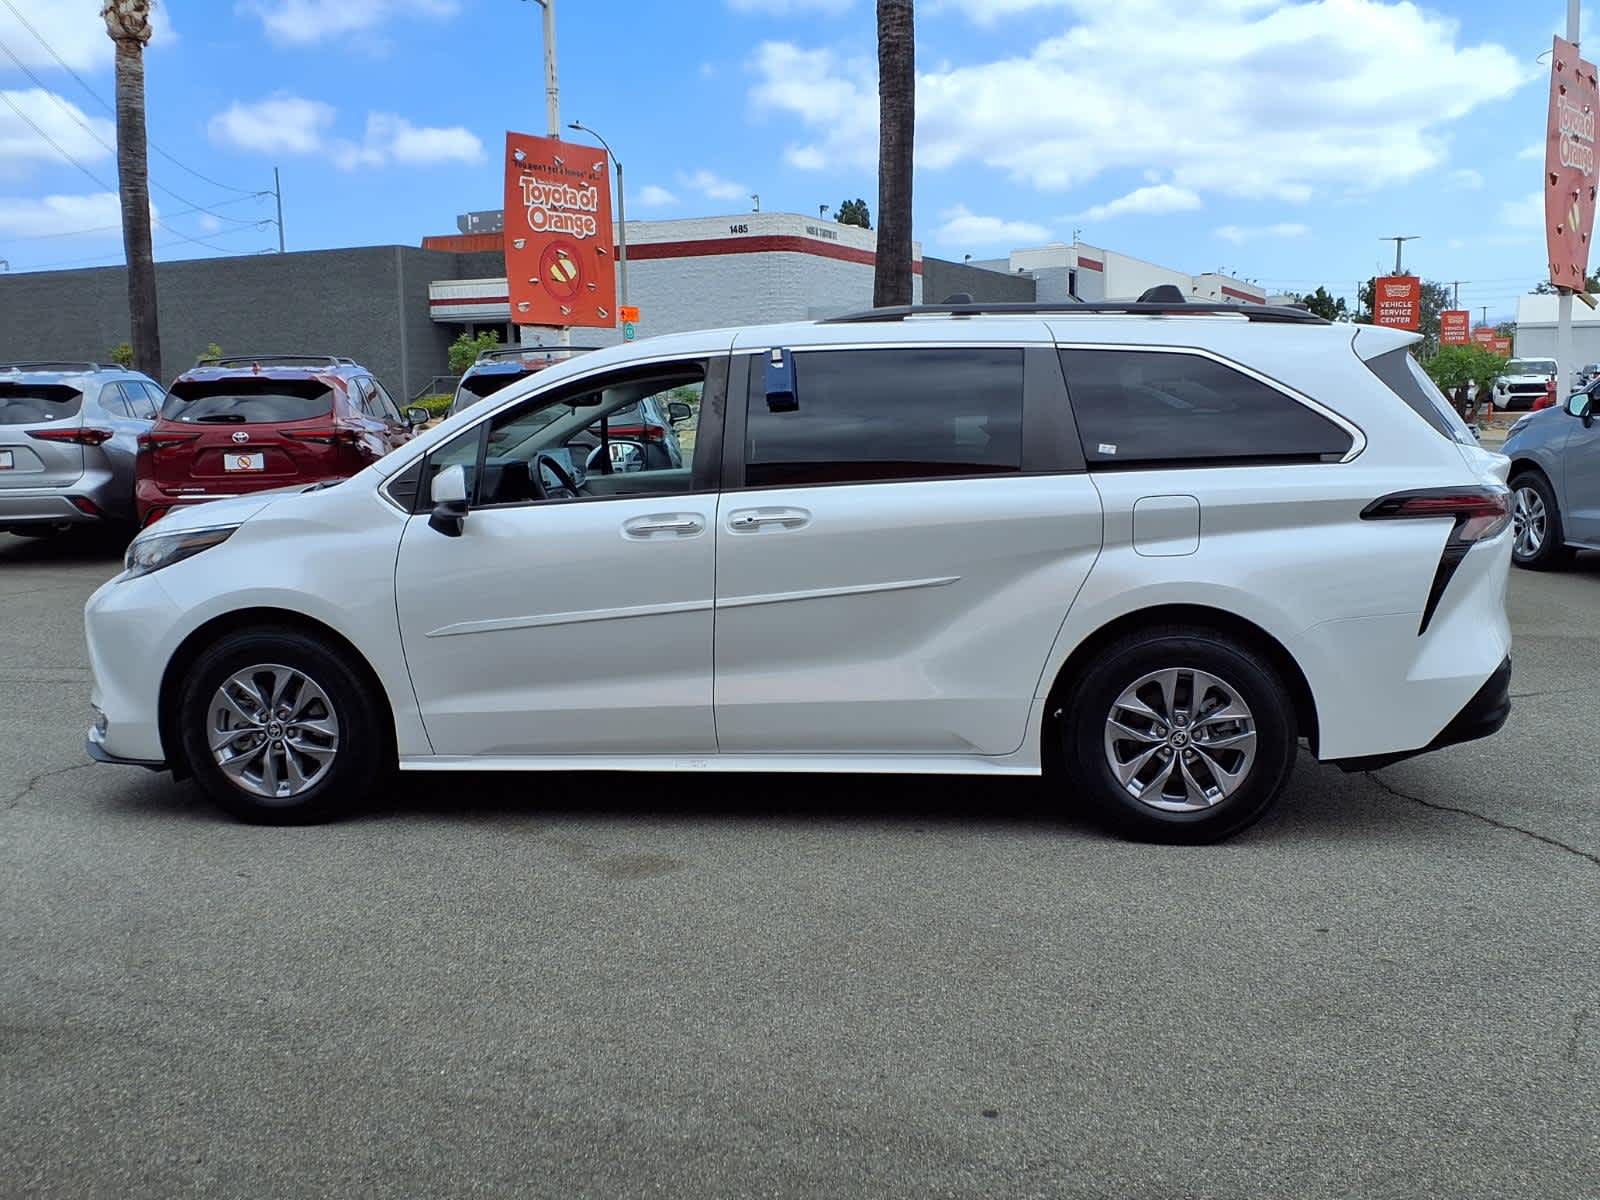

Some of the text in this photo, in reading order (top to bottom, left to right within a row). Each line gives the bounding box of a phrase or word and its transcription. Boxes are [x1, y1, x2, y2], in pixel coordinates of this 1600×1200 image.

[519, 175, 598, 211] Toyota of
[527, 204, 596, 239] Orange
[729, 224, 748, 234] 1485
[1379, 308, 1413, 316] SERVICE
